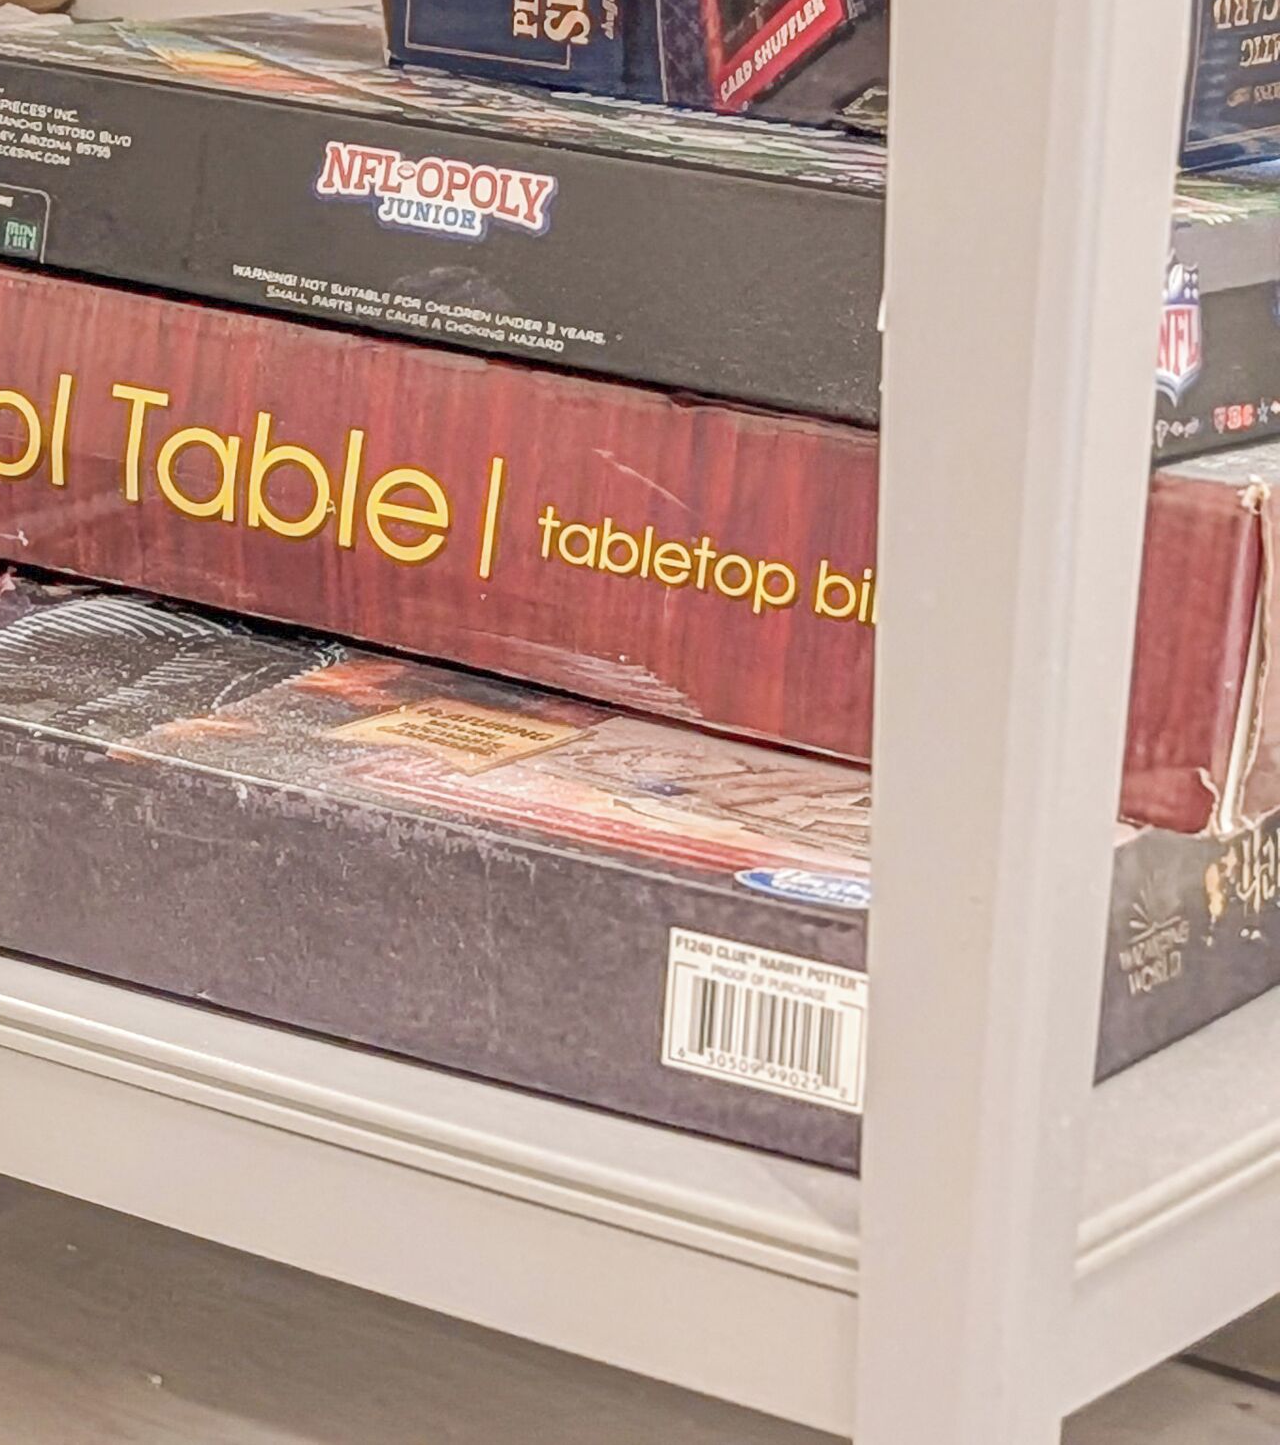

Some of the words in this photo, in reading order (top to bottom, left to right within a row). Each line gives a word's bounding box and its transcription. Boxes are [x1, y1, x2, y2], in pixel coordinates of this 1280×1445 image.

[720, 59, 753, 103] CARD
[21, 134, 73, 153] ARIZONA
[46, 122, 96, 142] VISTOSO
[99, 130, 133, 148] BLVD
[383, 196, 478, 230] JUNIOR
[5, 221, 38, 251] MIN
[265, 285, 309, 305] SMALL
[311, 294, 354, 315] PARTS
[355, 302, 383, 319] MAY
[385, 309, 429, 328] CAUSE
[431, 318, 442, 331] A
[444, 321, 506, 343] CHOKING
[507, 331, 566, 354] HAZARD
[300, 277, 328, 294] NOT
[330, 282, 391, 305] SUITABLE
[393, 294, 422, 311] FOR
[425, 299, 492, 324] CHILDREN
[494, 313, 543, 333] UNDER
[111, 383, 450, 563] Table
[537, 505, 797, 616] tabletop
[674, 935, 713, 957] F1240
[759, 955, 803, 976] HARRY
[710, 963, 747, 982] PROOF
[751, 973, 766, 986] OF
[767, 976, 828, 1002] PURCHASE
